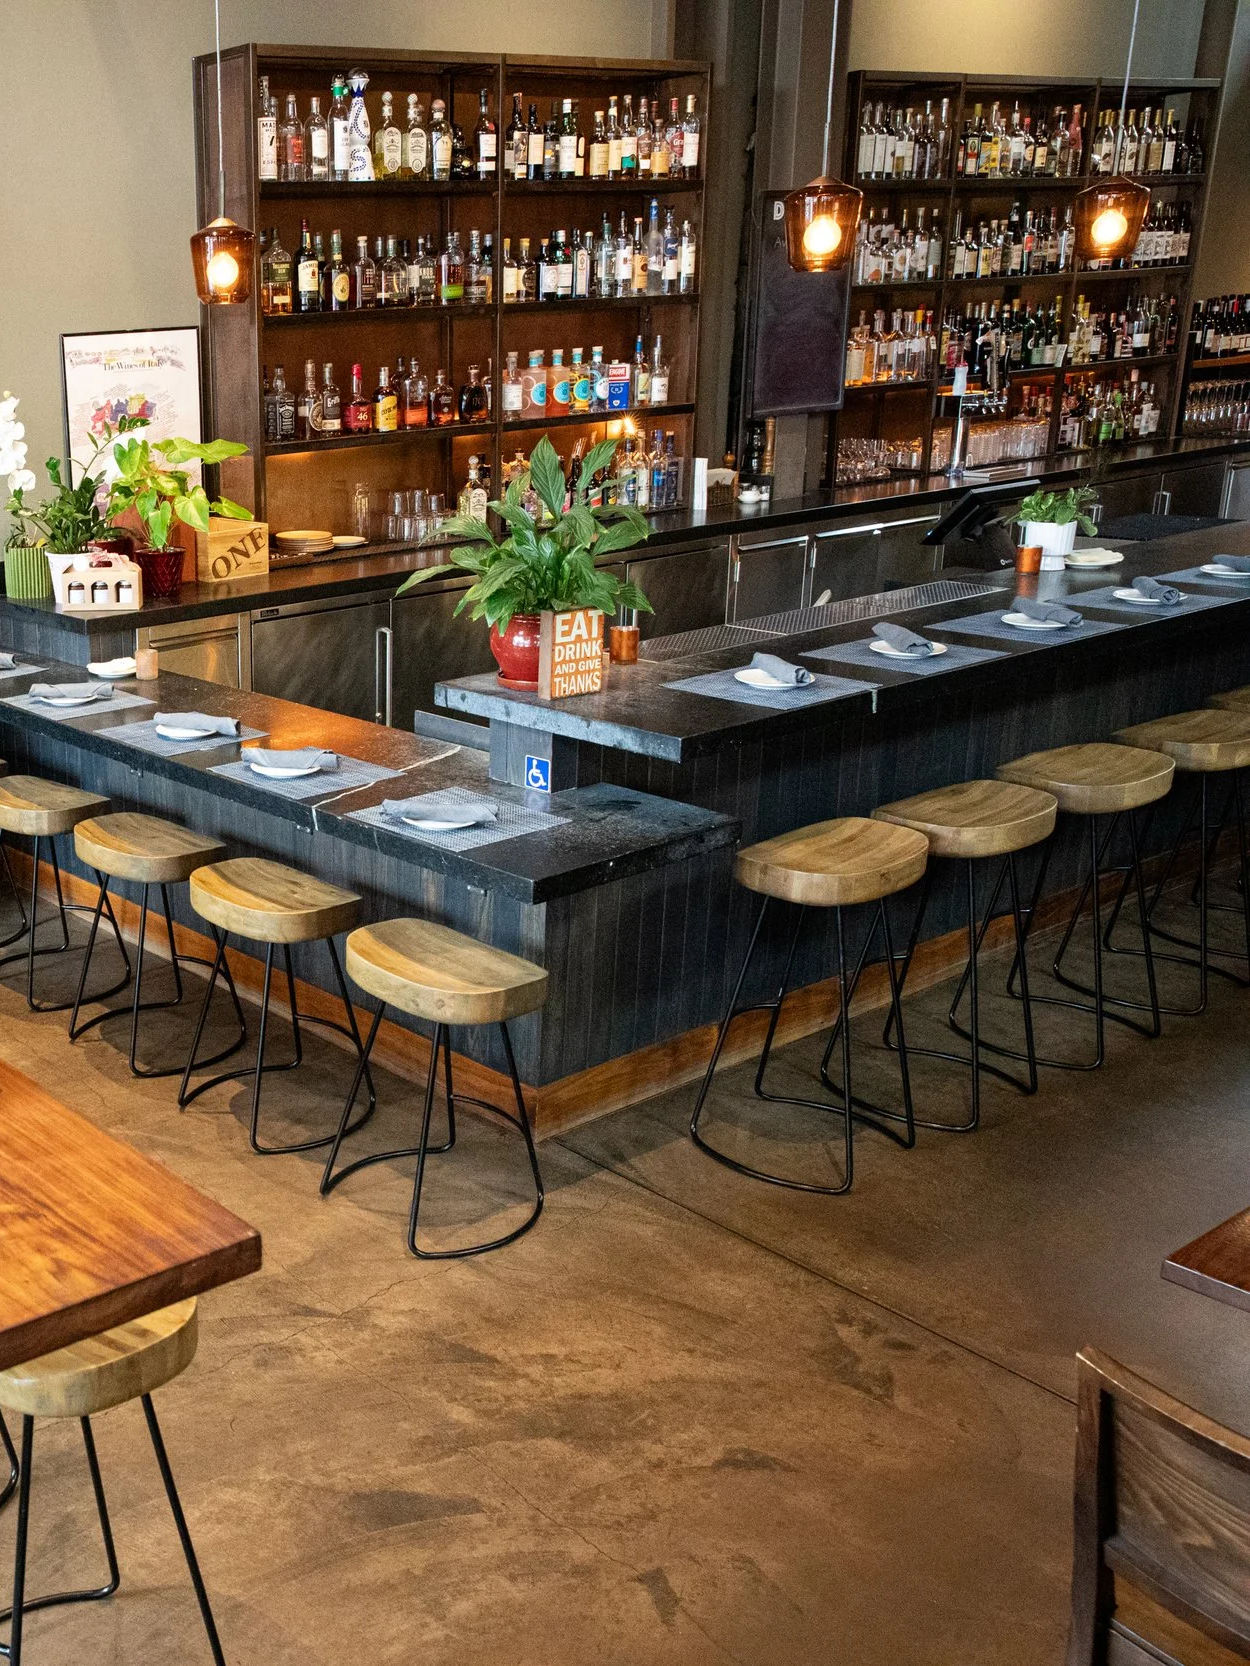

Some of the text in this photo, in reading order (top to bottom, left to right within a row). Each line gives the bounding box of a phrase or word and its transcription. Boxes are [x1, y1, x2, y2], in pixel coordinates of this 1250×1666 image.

[103, 362, 116, 371] The
[116, 361, 138, 370] Wines
[138, 360, 146, 369] of
[147, 359, 164, 370] Italy
[609, 367, 626, 376] ENGINE
[212, 527, 266, 579] ONE
[554, 609, 604, 644] EAT
[554, 640, 603, 663] DRINK
[554, 658, 602, 676] AND GIVE
[554, 671, 601, 697] THANKS
